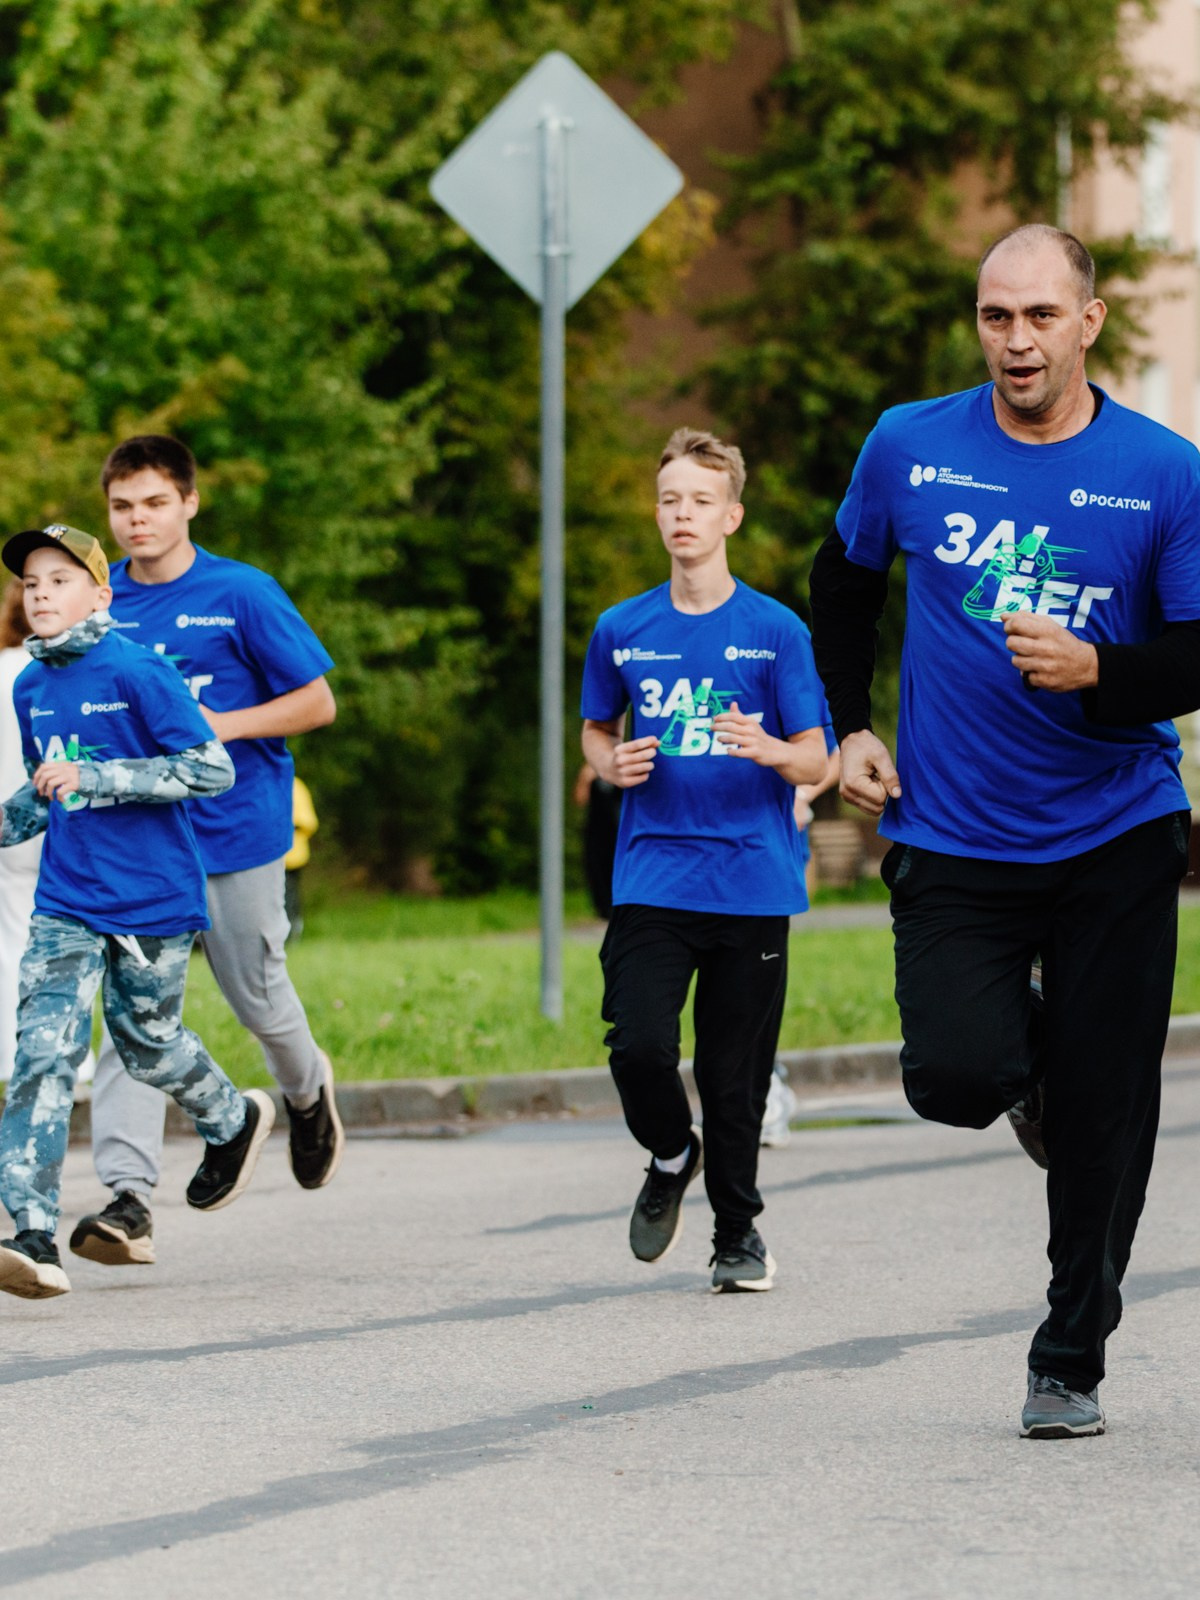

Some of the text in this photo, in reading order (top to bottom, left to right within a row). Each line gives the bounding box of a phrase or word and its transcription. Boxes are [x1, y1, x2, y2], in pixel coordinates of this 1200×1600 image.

[936, 478, 1009, 493] ПРОМЫШЛЕННОСТИ
[937, 473, 973, 481] АТОМНОЙ
[1088, 494, 1151, 511] РОСАТОМ
[933, 511, 1050, 575] ЗА!
[639, 677, 714, 719] ЗА!
